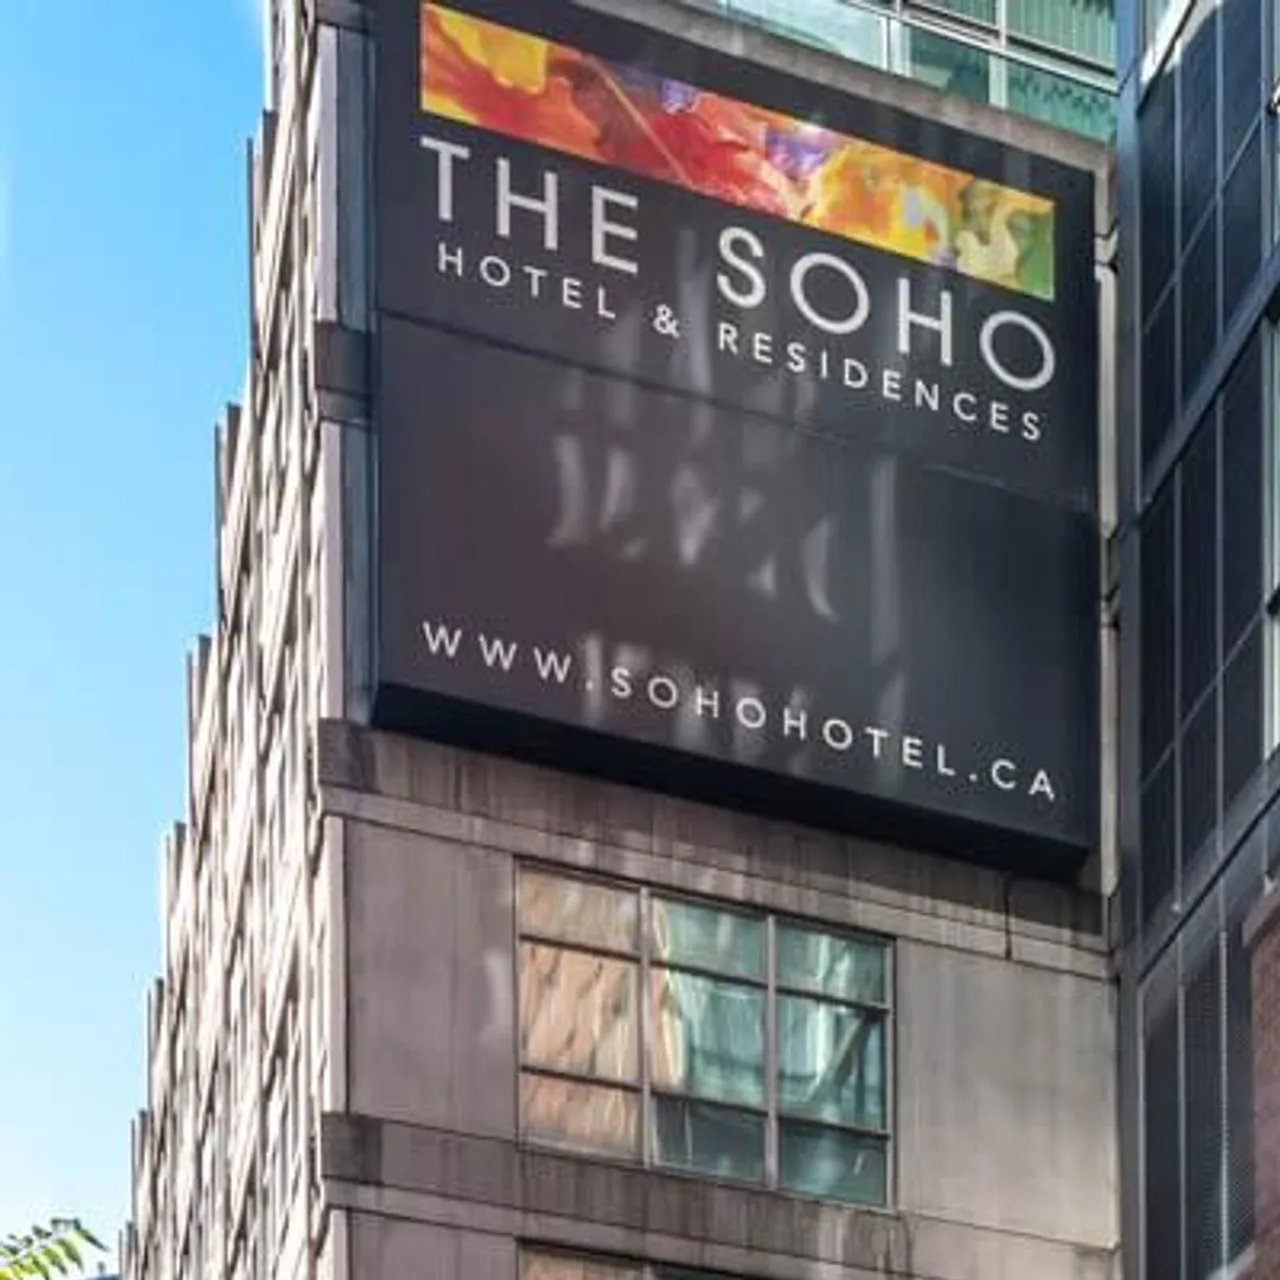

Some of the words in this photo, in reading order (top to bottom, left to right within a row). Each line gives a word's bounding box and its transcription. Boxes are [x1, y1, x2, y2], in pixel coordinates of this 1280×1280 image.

[420, 136, 638, 275] THE
[717, 225, 1057, 391] SOHO
[437, 243, 616, 320] HOTEL
[652, 302, 681, 340] &
[719, 321, 1043, 443] RESIDENCES
[422, 620, 1057, 800] WWW.SOHOHOTEL.CA
